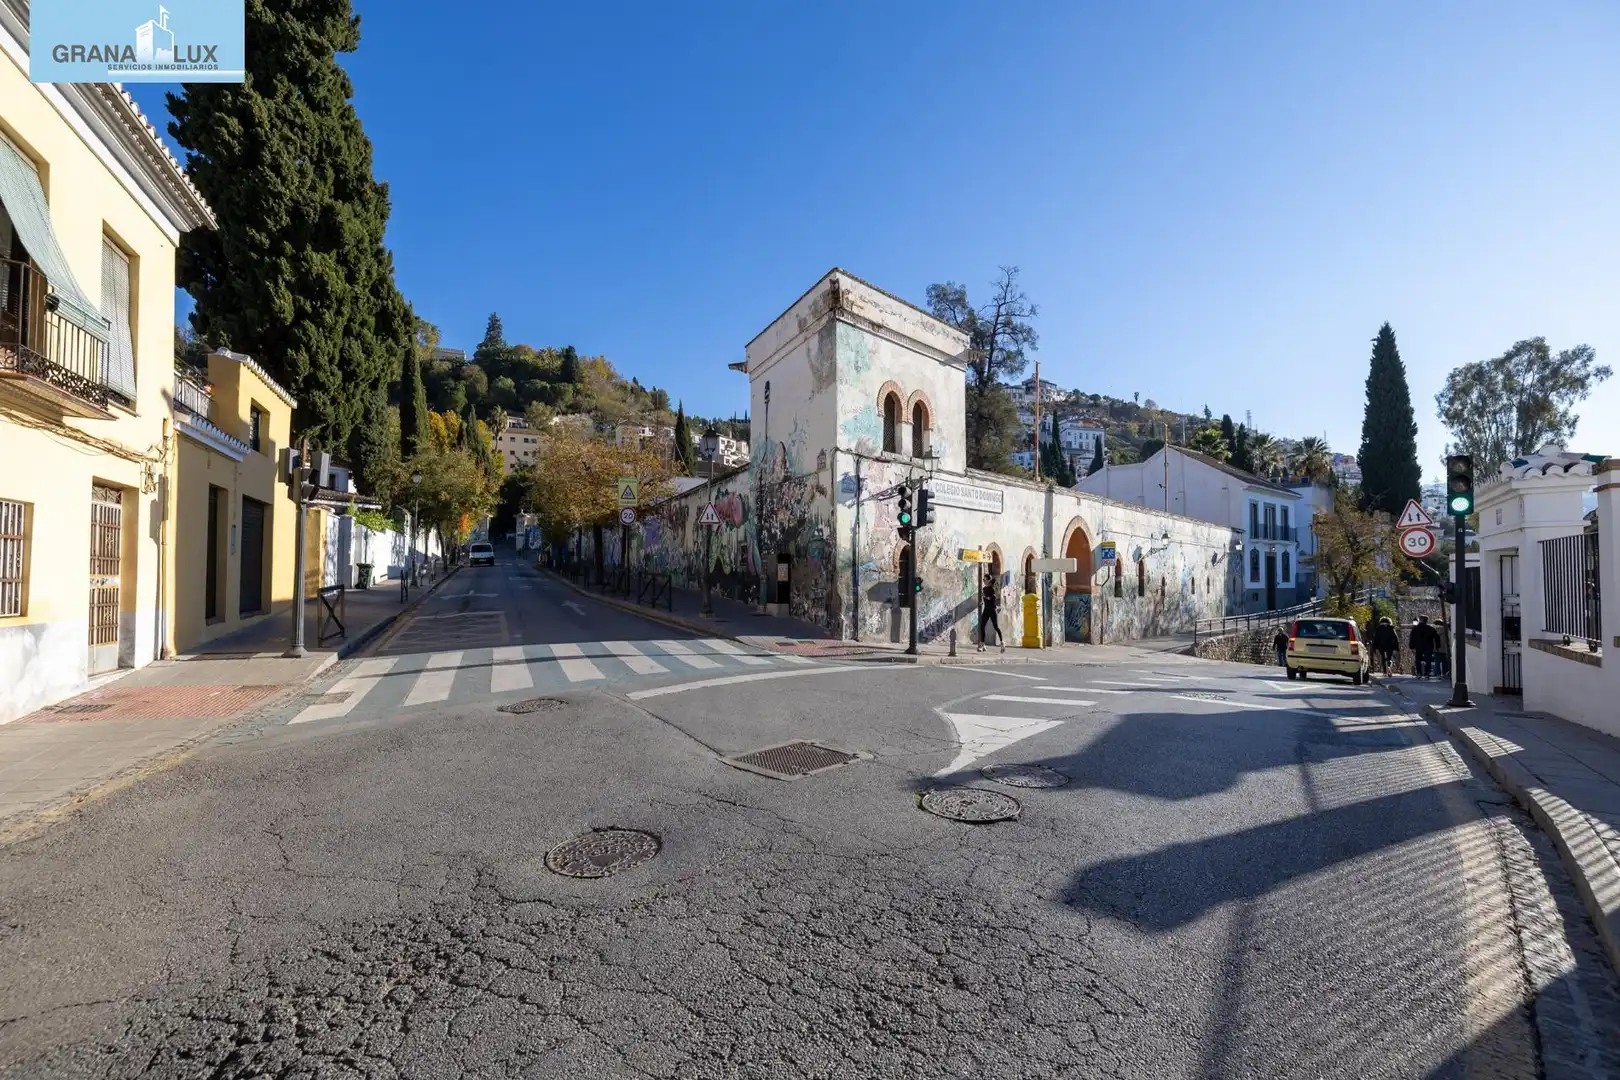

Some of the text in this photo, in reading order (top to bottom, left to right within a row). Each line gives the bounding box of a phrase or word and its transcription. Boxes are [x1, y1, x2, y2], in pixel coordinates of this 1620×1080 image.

[935, 482, 960, 496] COLEGIO
[961, 487, 979, 499] SANTO
[979, 489, 1002, 503] DOMINGO
[1407, 537, 1427, 547] 30
